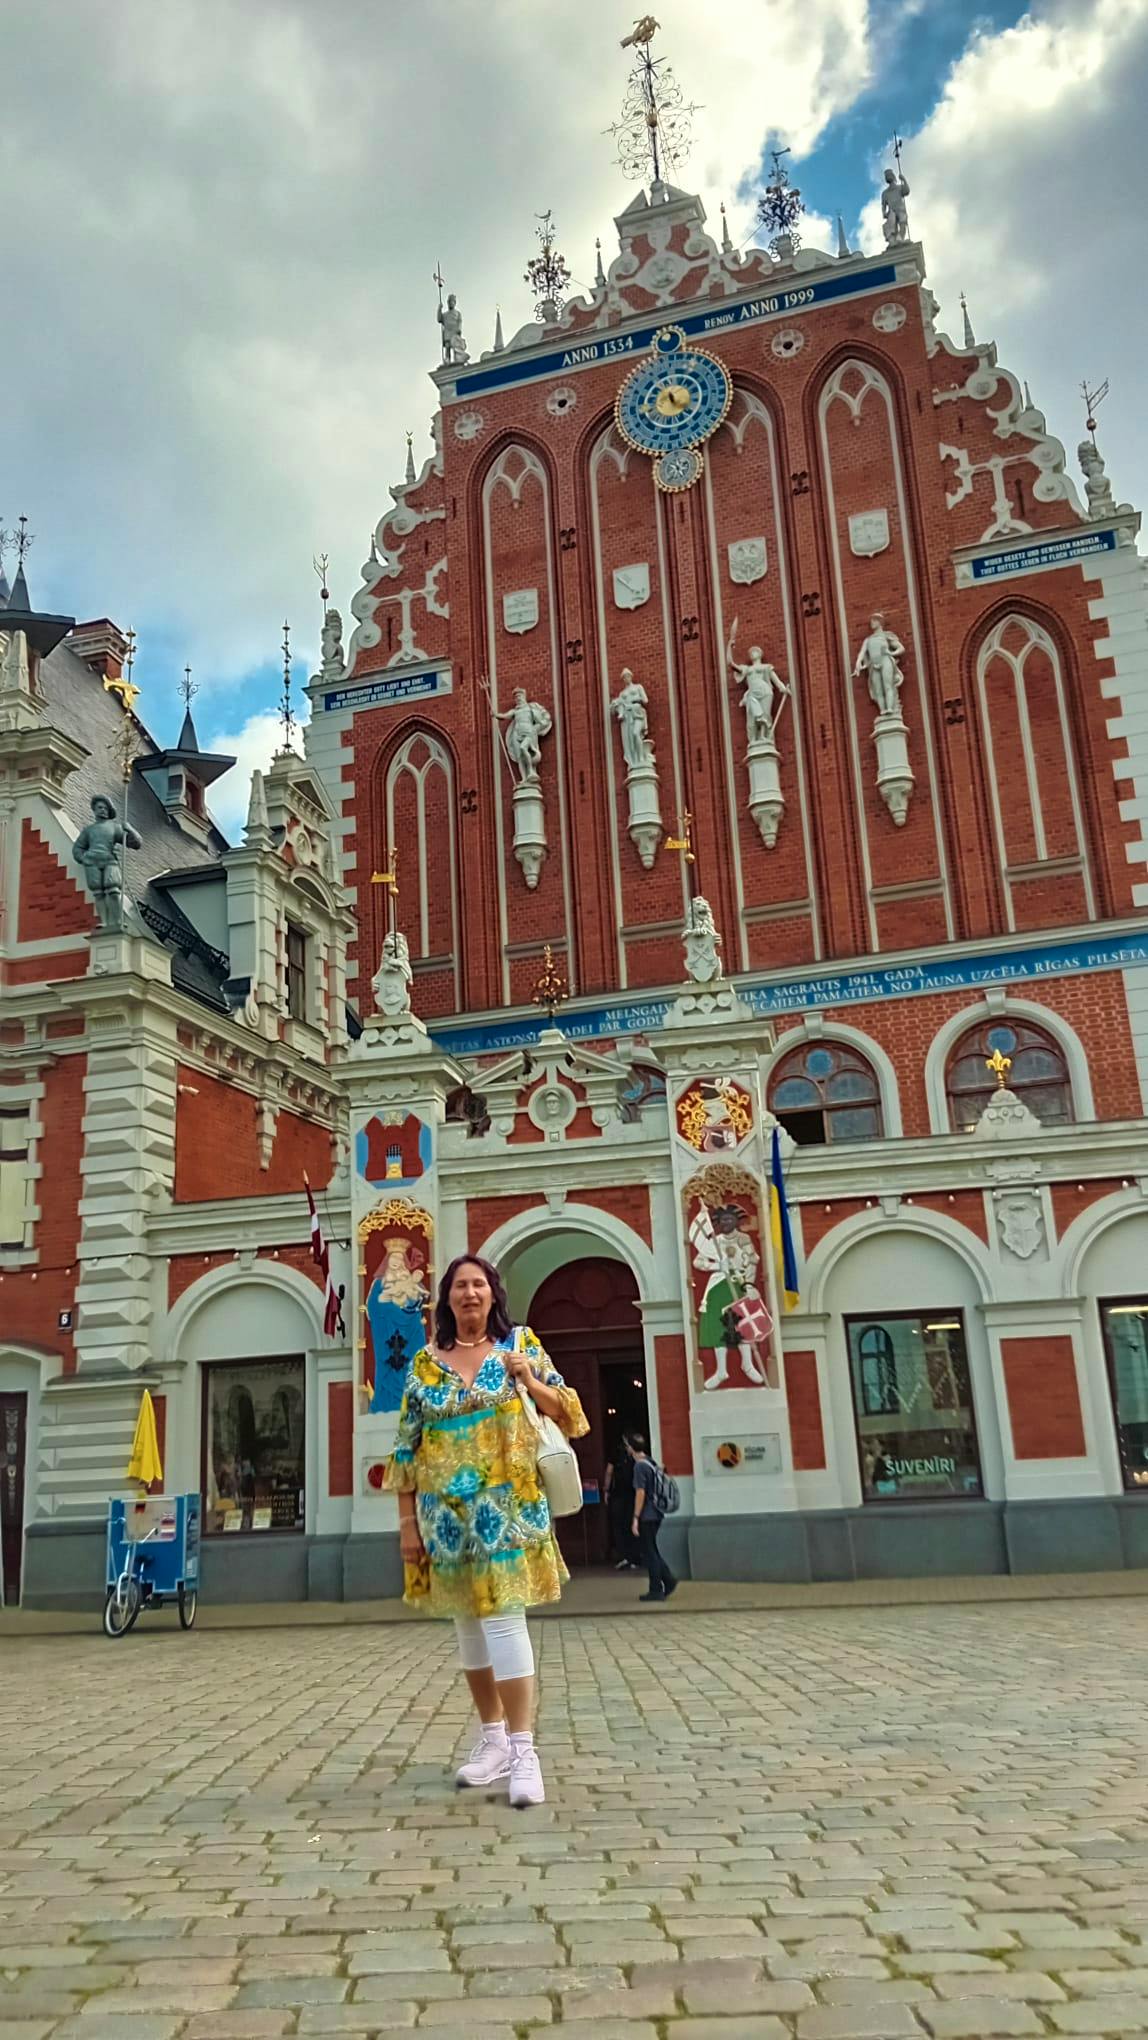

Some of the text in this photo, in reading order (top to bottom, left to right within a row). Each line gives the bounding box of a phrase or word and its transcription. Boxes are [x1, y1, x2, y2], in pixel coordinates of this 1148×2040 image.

[562, 345, 598, 367] ANNO
[604, 336, 633, 355] 1334
[740, 298, 778, 320] ANNO
[784, 289, 815, 308] 1999
[599, 1020, 621, 1032] PAR
[752, 995, 807, 1011] ECAJIEM
[814, 985, 883, 1003] PAMATIEM
[890, 980, 912, 992] NO
[920, 973, 964, 990] JAUNA
[774, 979, 840, 998] SAGRAUTS
[61, 1313, 69, 1325] 6
